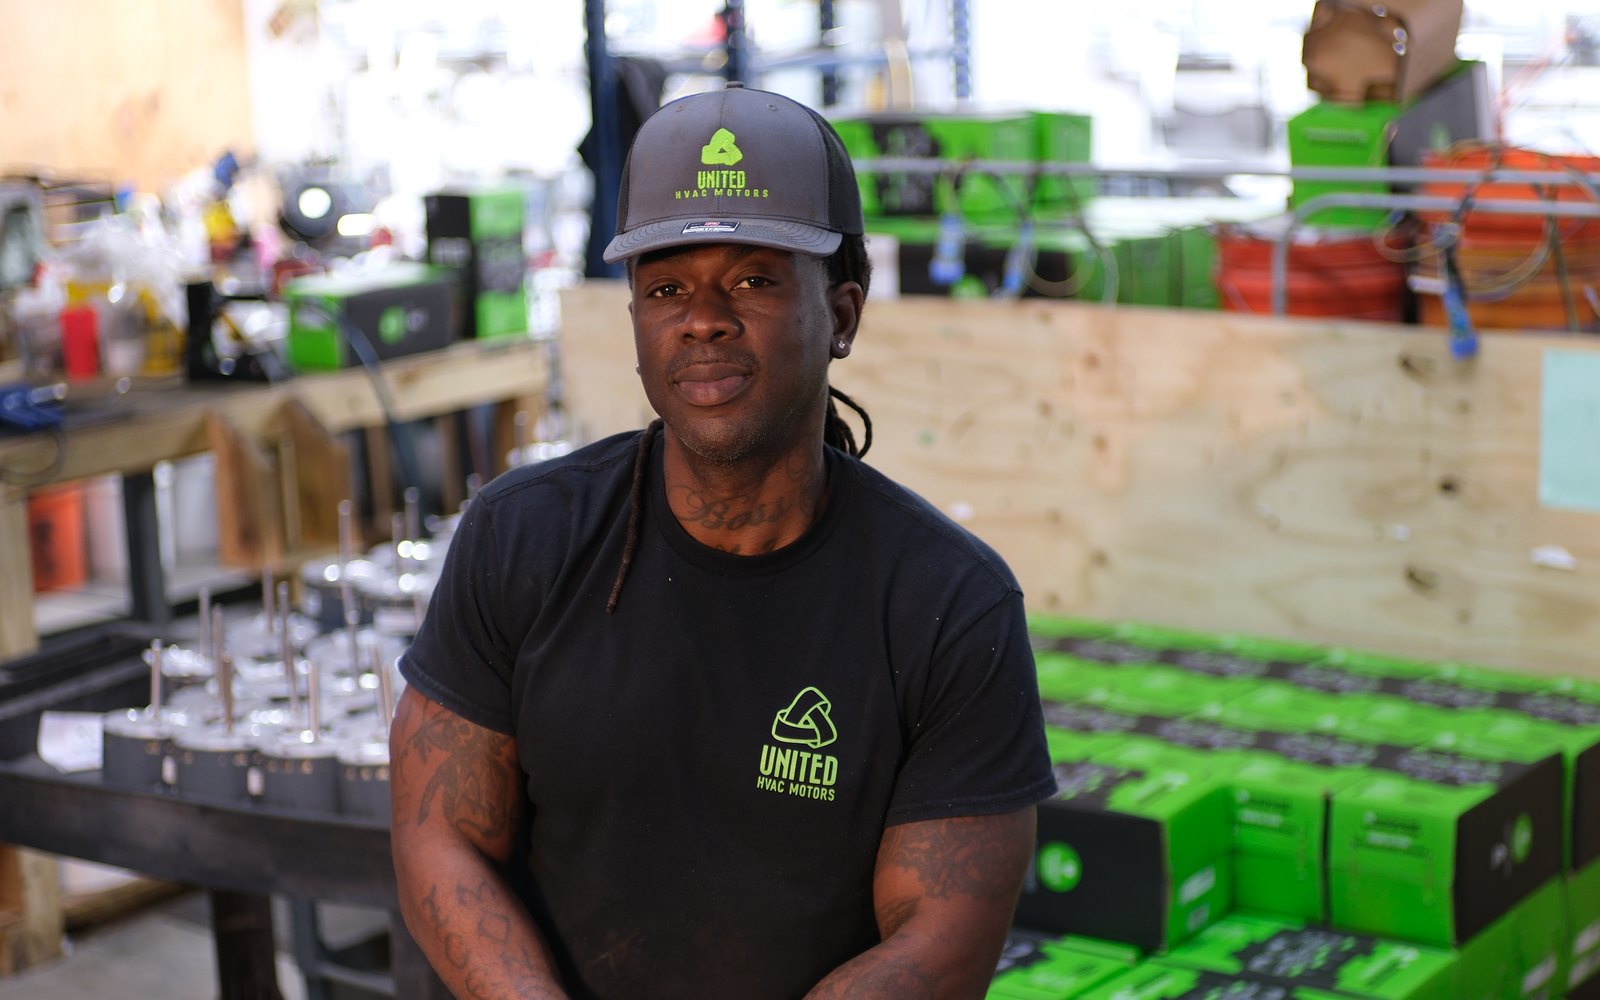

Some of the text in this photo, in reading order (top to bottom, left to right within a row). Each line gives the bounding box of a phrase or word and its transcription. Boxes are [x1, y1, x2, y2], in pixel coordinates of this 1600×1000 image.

[697, 170, 746, 189] UNITED
[675, 188, 769, 199] HVAC MOTORS
[760, 745, 838, 785] UNITED
[756, 776, 835, 801] HVAC MOTORS
